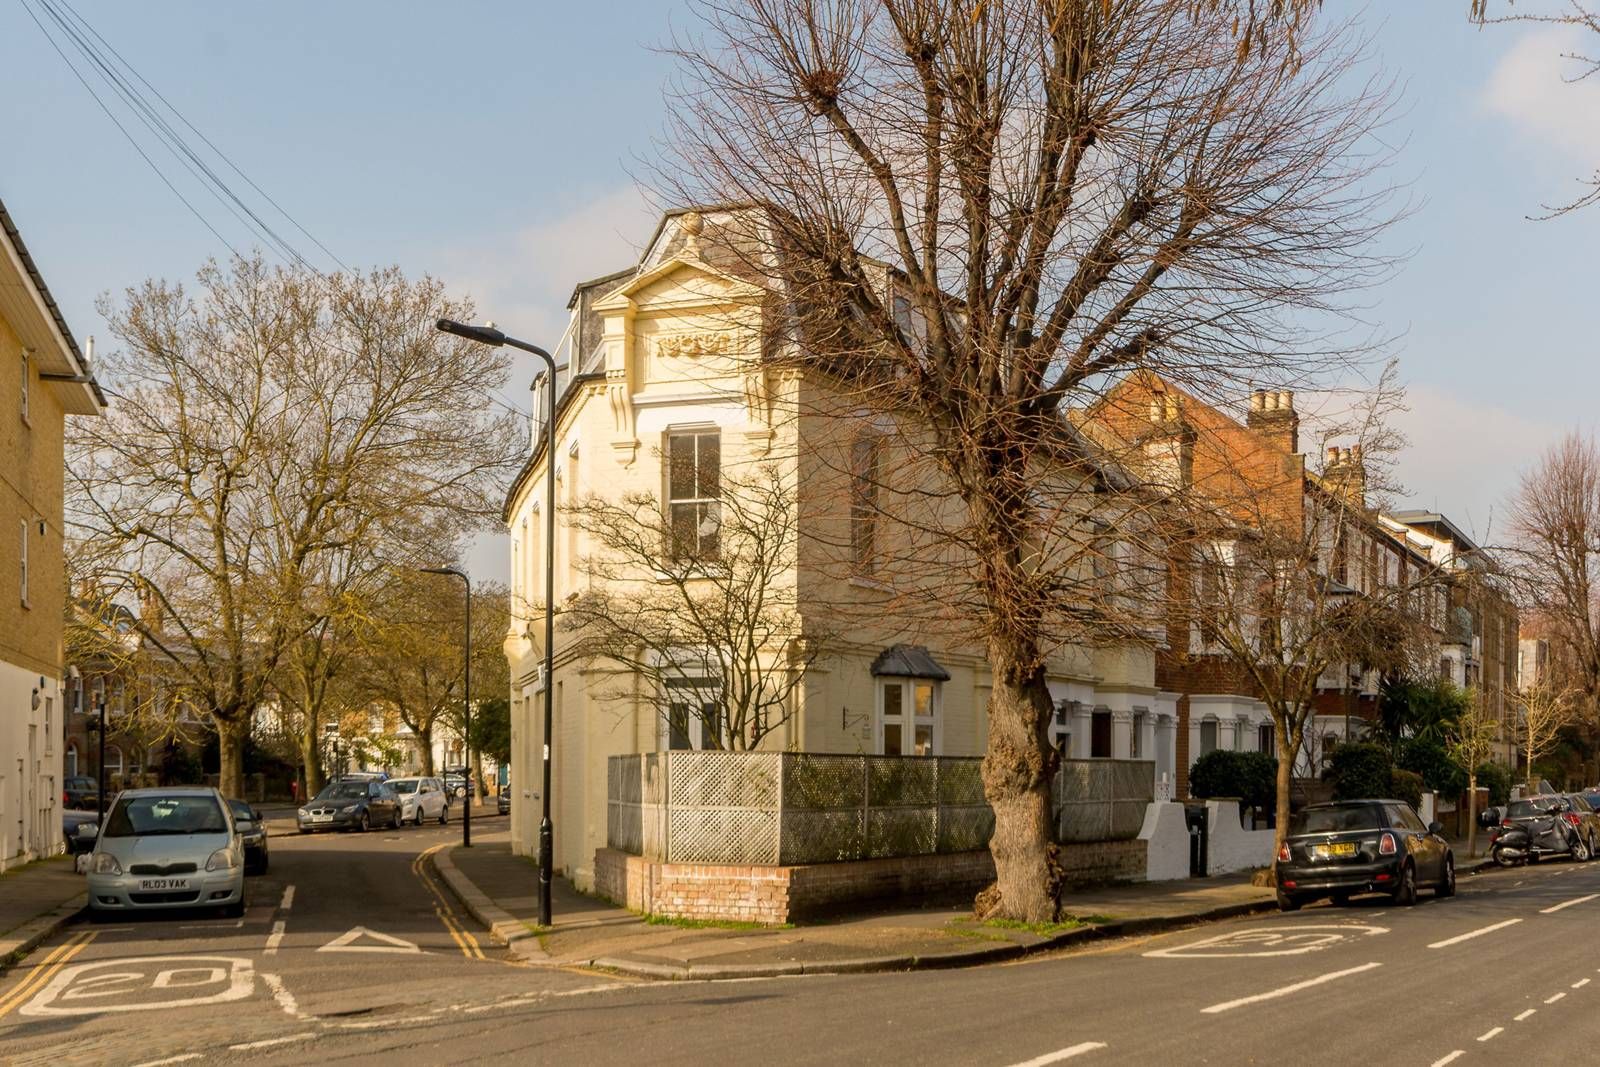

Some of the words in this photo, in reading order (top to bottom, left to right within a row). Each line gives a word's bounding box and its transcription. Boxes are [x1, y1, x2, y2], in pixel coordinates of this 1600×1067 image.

[142, 880, 167, 889] RL03
[169, 879, 186, 889] VAK
[61, 967, 228, 1000] 20
